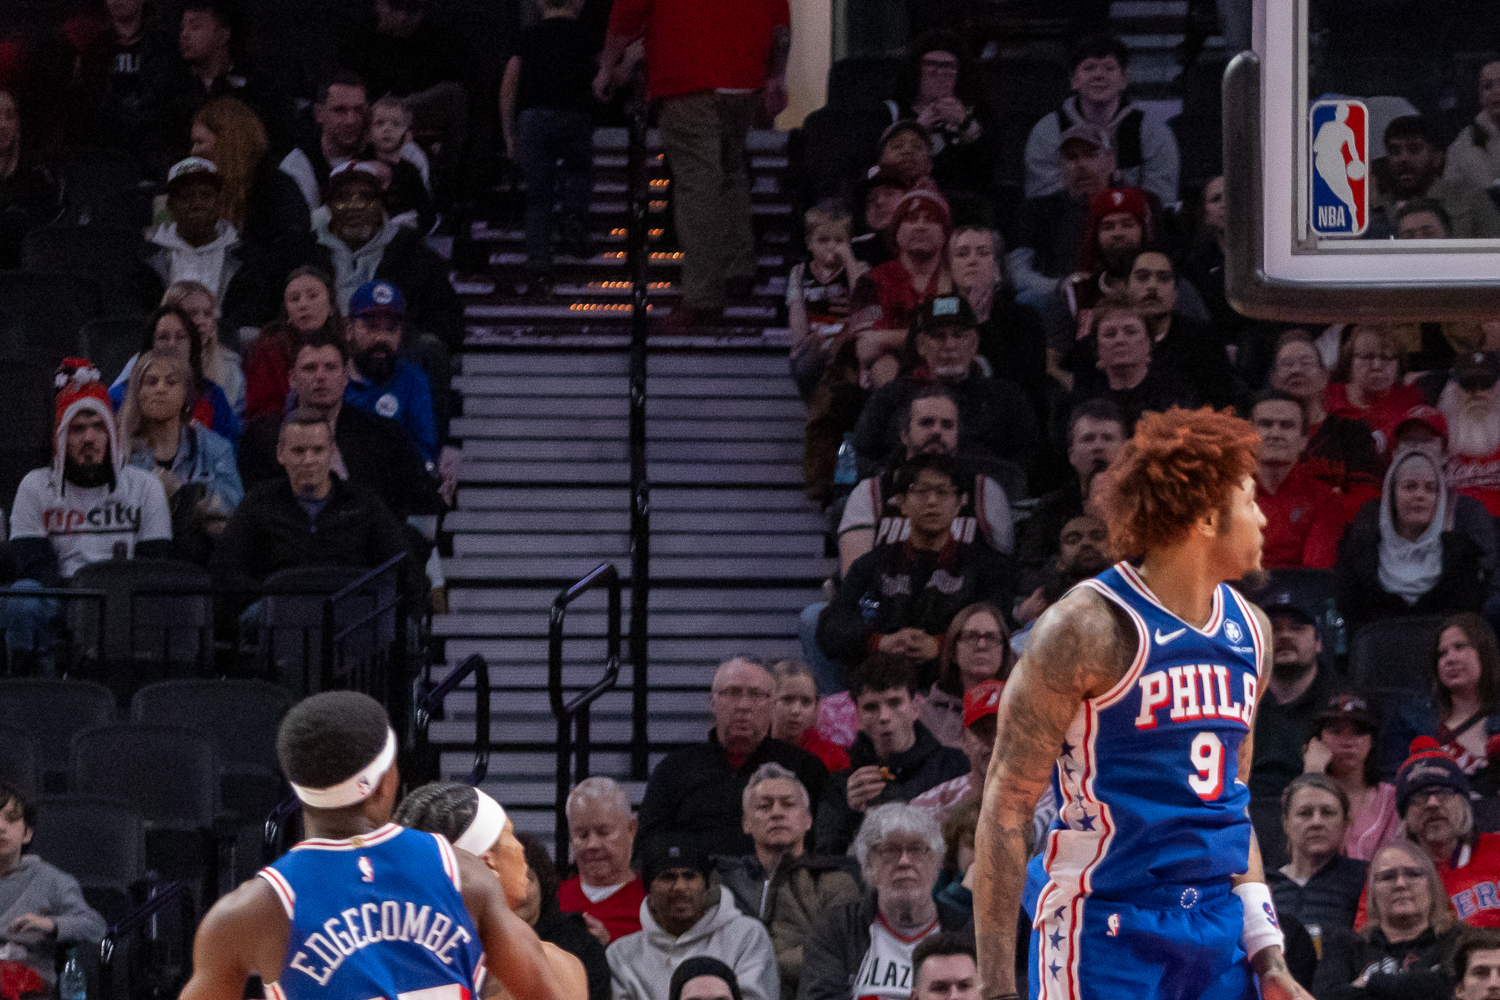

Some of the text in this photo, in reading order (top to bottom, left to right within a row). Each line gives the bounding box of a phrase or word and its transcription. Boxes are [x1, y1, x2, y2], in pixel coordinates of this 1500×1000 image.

[1318, 205, 1346, 227] NBA
[1135, 664, 1257, 730] PHILA
[1188, 732, 1225, 801] 9
[290, 900, 471, 985] EDGECOMBE
